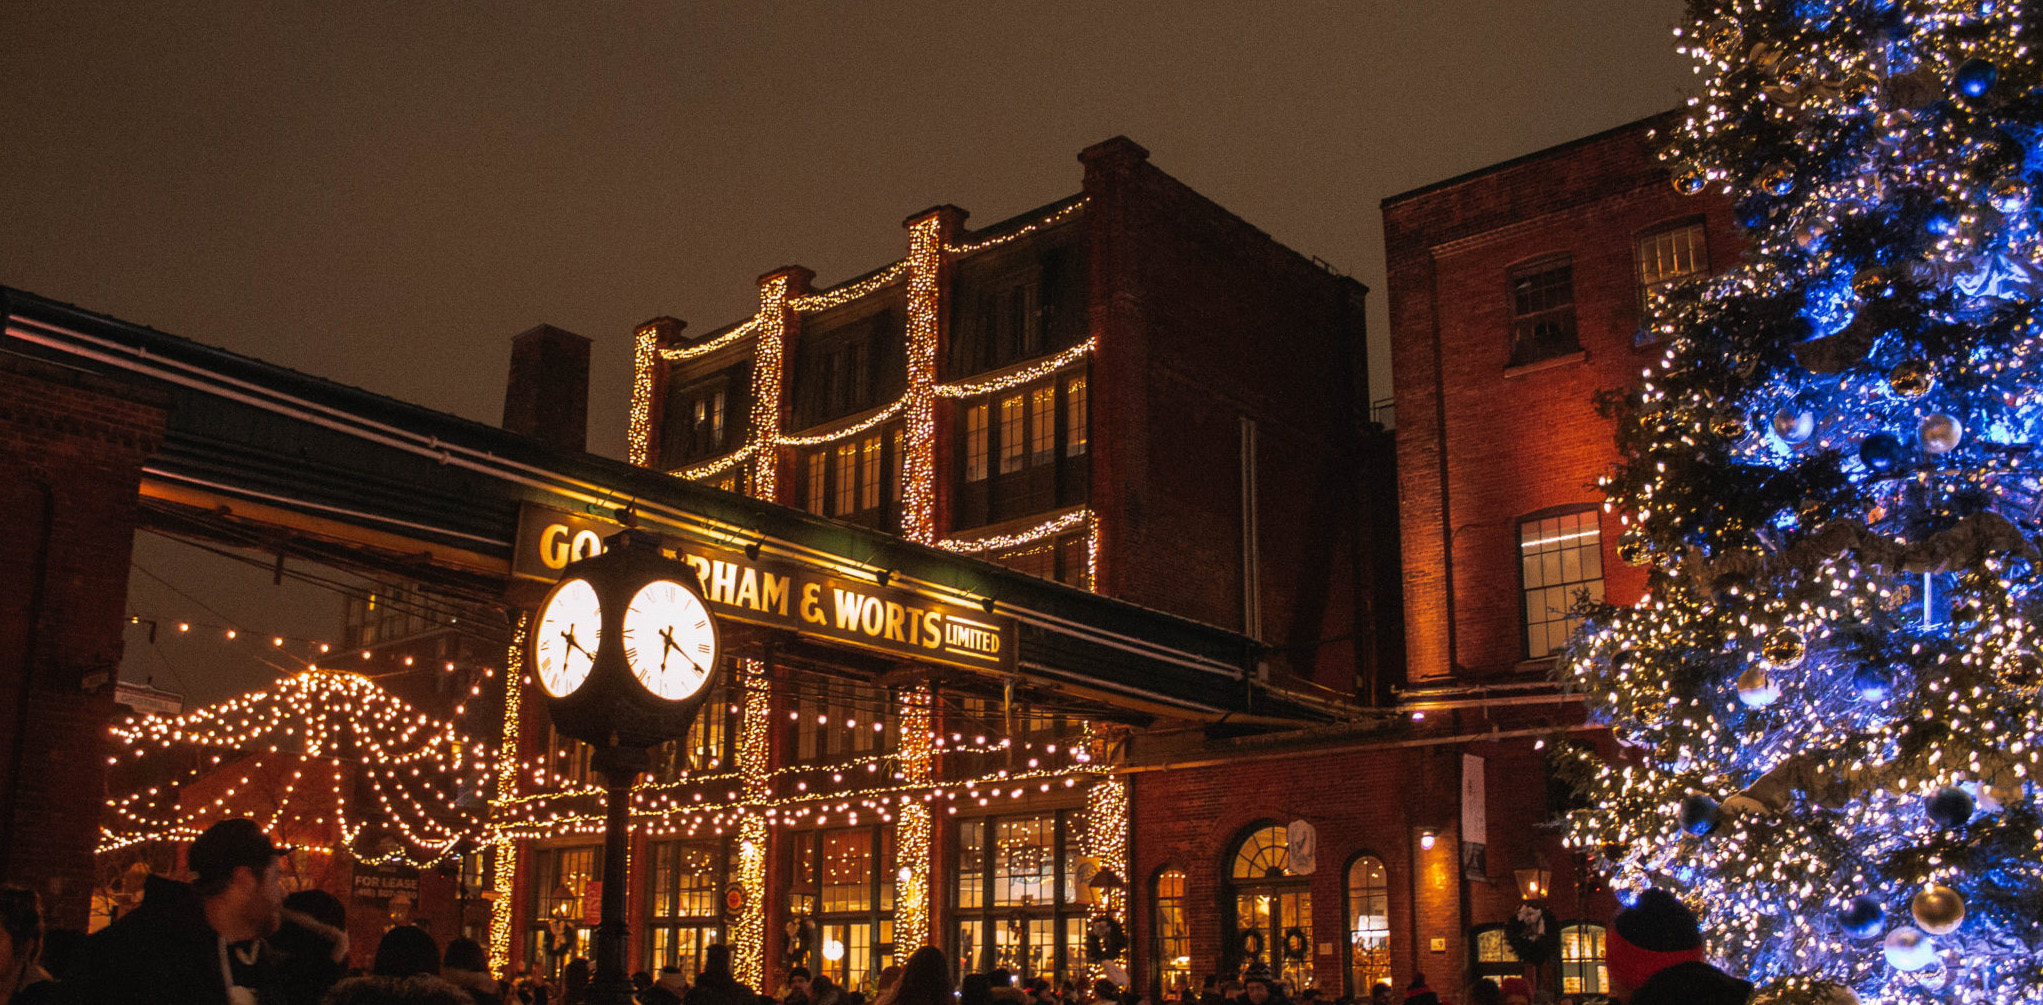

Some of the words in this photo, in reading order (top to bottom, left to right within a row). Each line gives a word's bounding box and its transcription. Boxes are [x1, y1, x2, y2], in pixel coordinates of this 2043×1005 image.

[539, 523, 790, 616] GORHAM
[801, 582, 827, 626] &
[833, 588, 942, 649] WORTS
[945, 622, 1000, 653] LIMITED
[355, 876, 379, 887] FOR
[383, 877, 417, 888] LEASE
